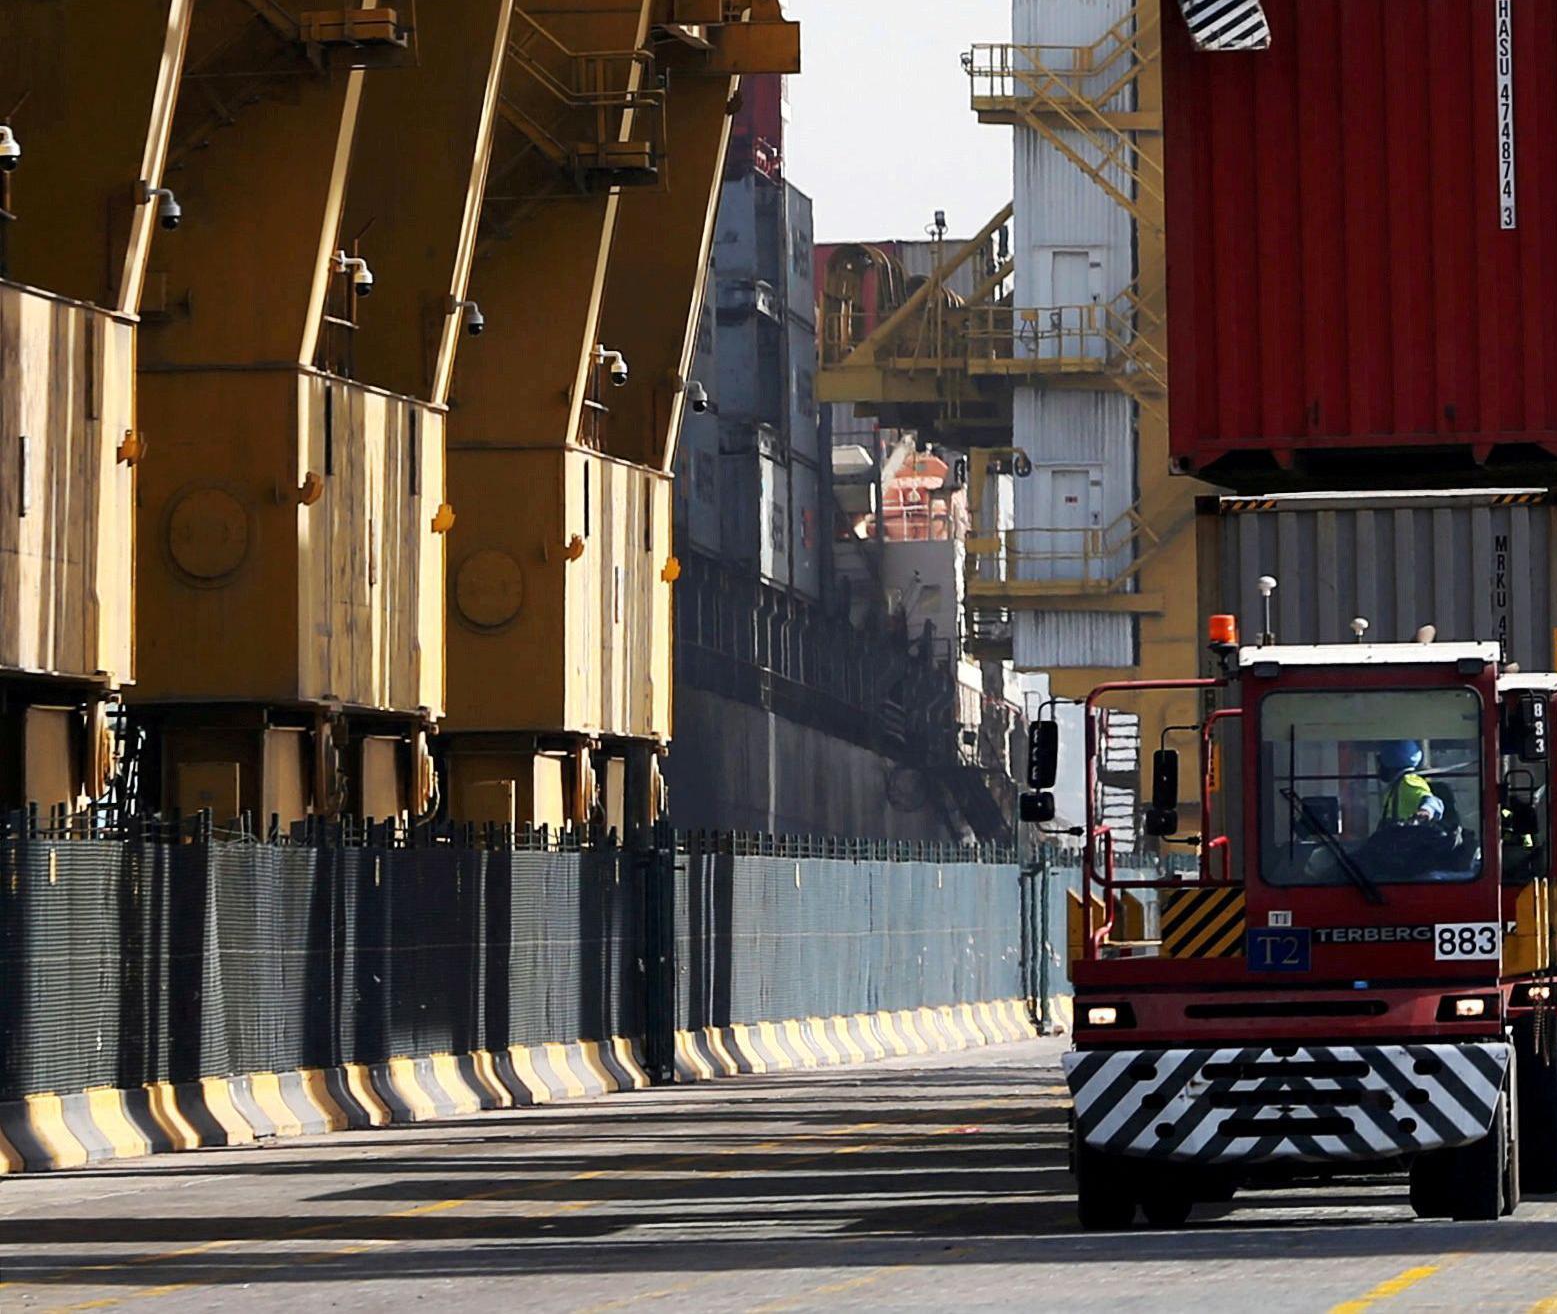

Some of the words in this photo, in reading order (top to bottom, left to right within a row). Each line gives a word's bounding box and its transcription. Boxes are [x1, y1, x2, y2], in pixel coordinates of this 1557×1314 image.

[1498, 0, 1509, 76] HASU
[1501, 84, 1511, 198] 474874
[1504, 209, 1512, 226] 3
[1495, 536, 1508, 608] MRKU
[1257, 936, 1300, 964] T2
[1315, 926, 1432, 942] TERBERG
[1439, 926, 1496, 955] 883
